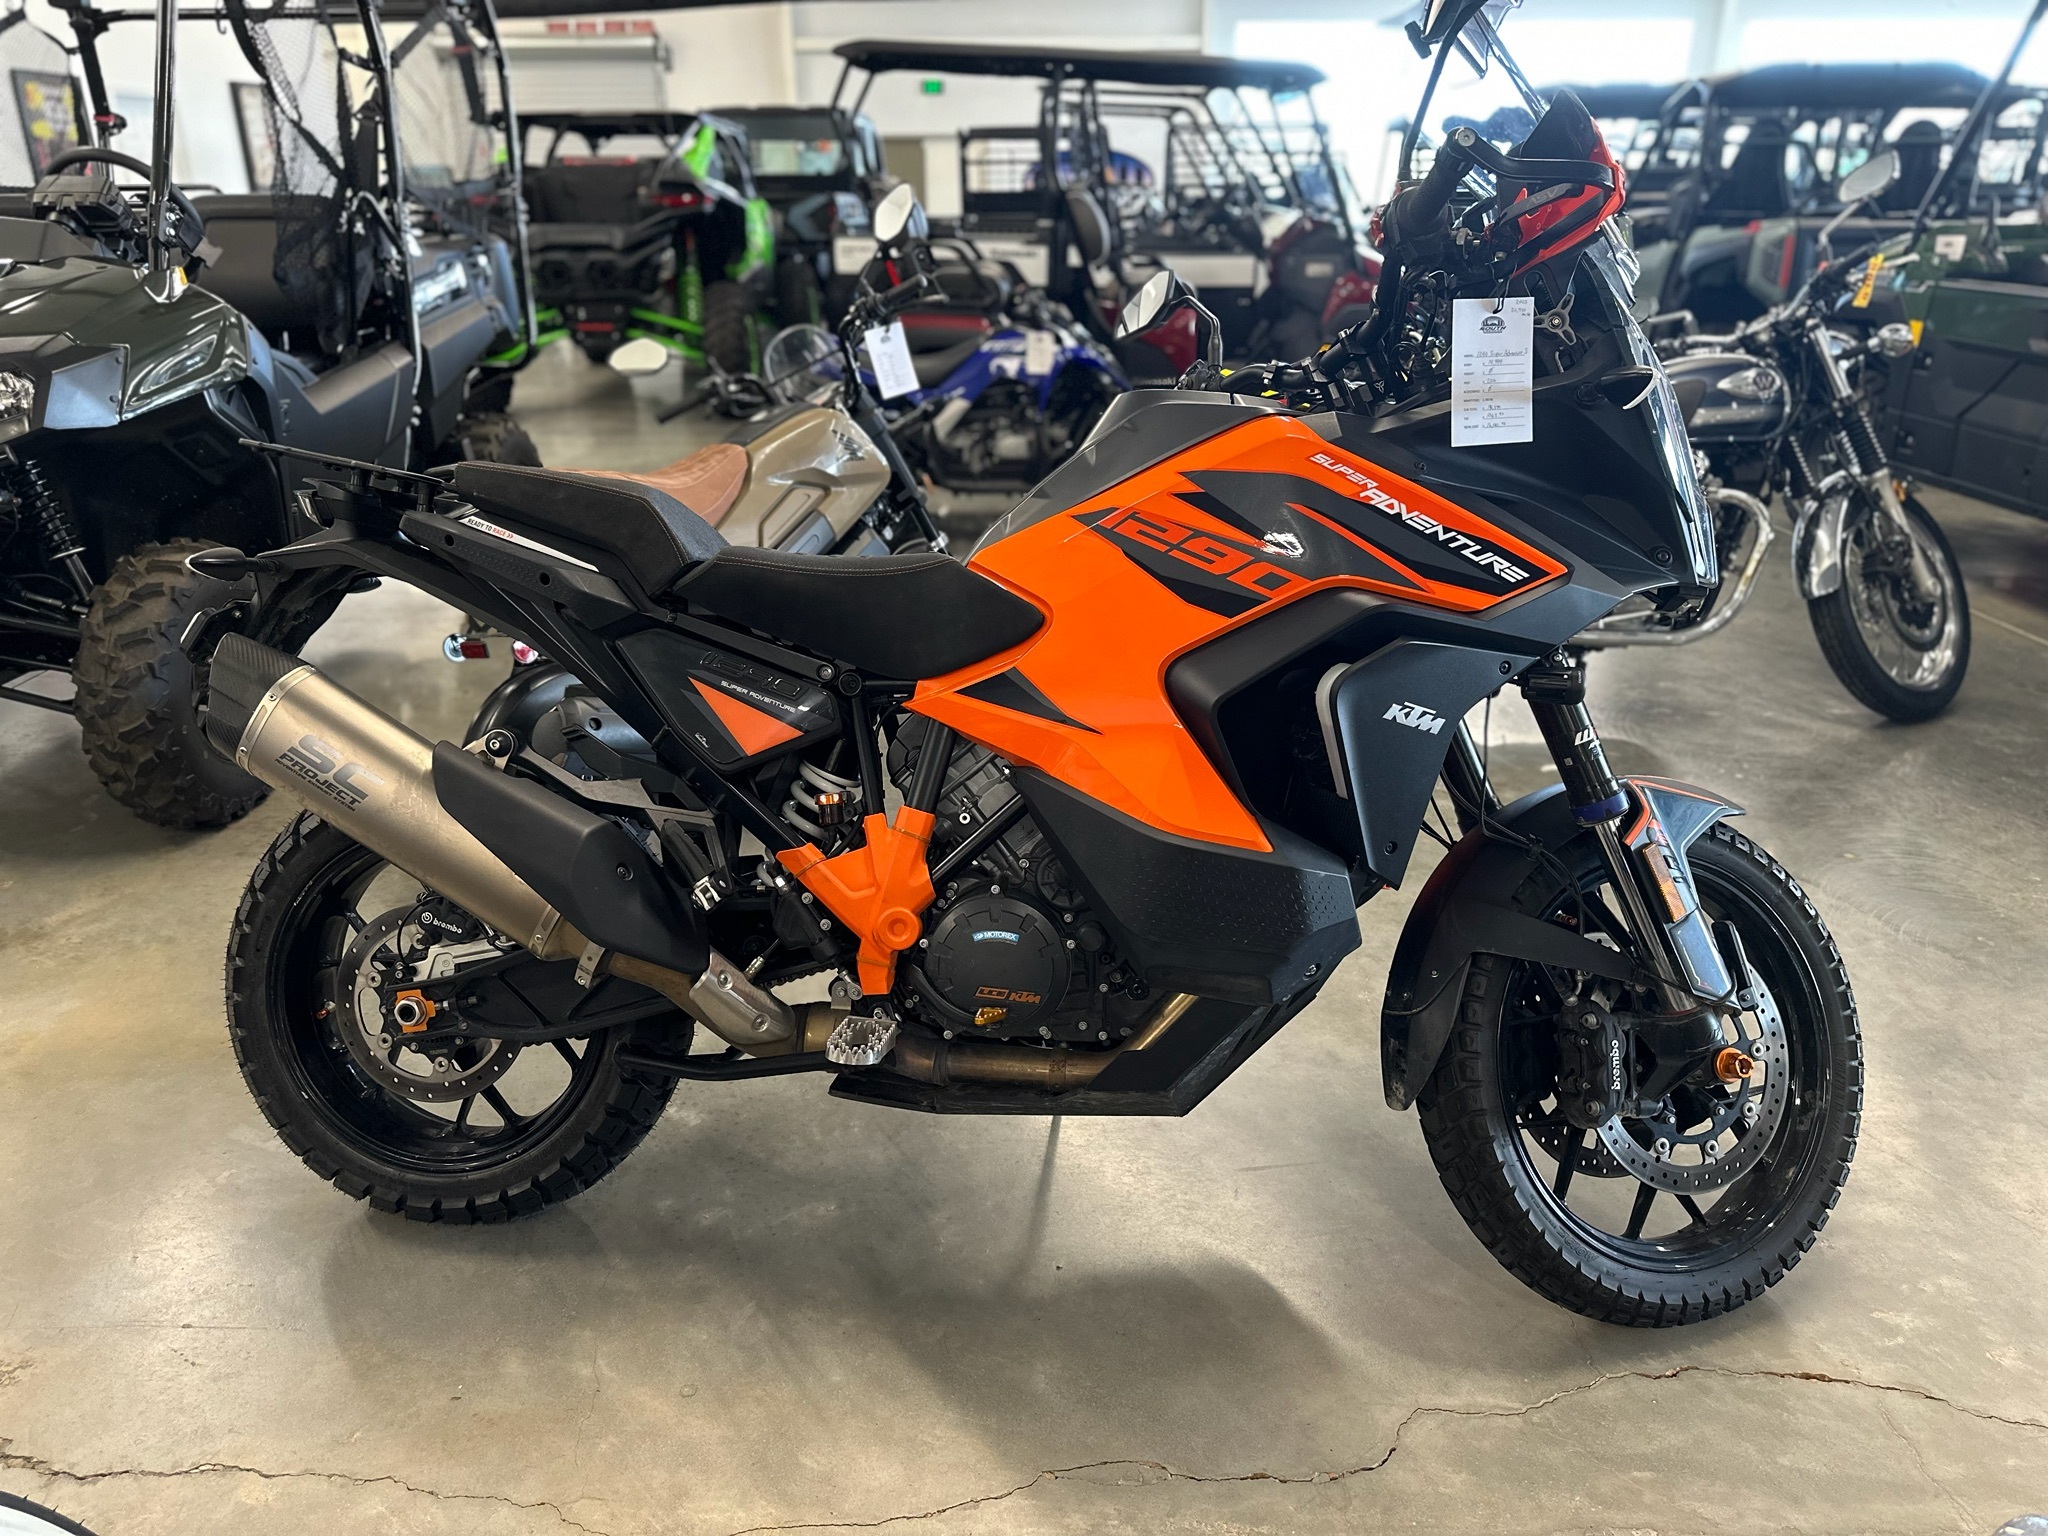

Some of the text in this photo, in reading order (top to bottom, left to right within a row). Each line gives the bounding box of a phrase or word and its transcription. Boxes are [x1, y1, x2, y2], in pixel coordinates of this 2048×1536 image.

[1527, 188, 1559, 209] ASV
[1309, 453, 1379, 489] SUPER
[469, 519, 506, 537] READY TO RACE
[1359, 487, 1531, 583] ADVENTURE
[1098, 506, 1312, 600] 1290
[720, 680, 797, 713] SUPER ADVENTURE
[1382, 701, 1446, 735] KTM
[274, 758, 356, 812] ADVENTURE EXHAUST SYSTEM
[278, 752, 362, 806] PROJECT
[286, 734, 385, 801] SC
[432, 917, 463, 934] brembo
[983, 930, 1015, 940] MOTOREX
[1009, 991, 1041, 1004] KTM
[1610, 1039, 1621, 1090] brembo
